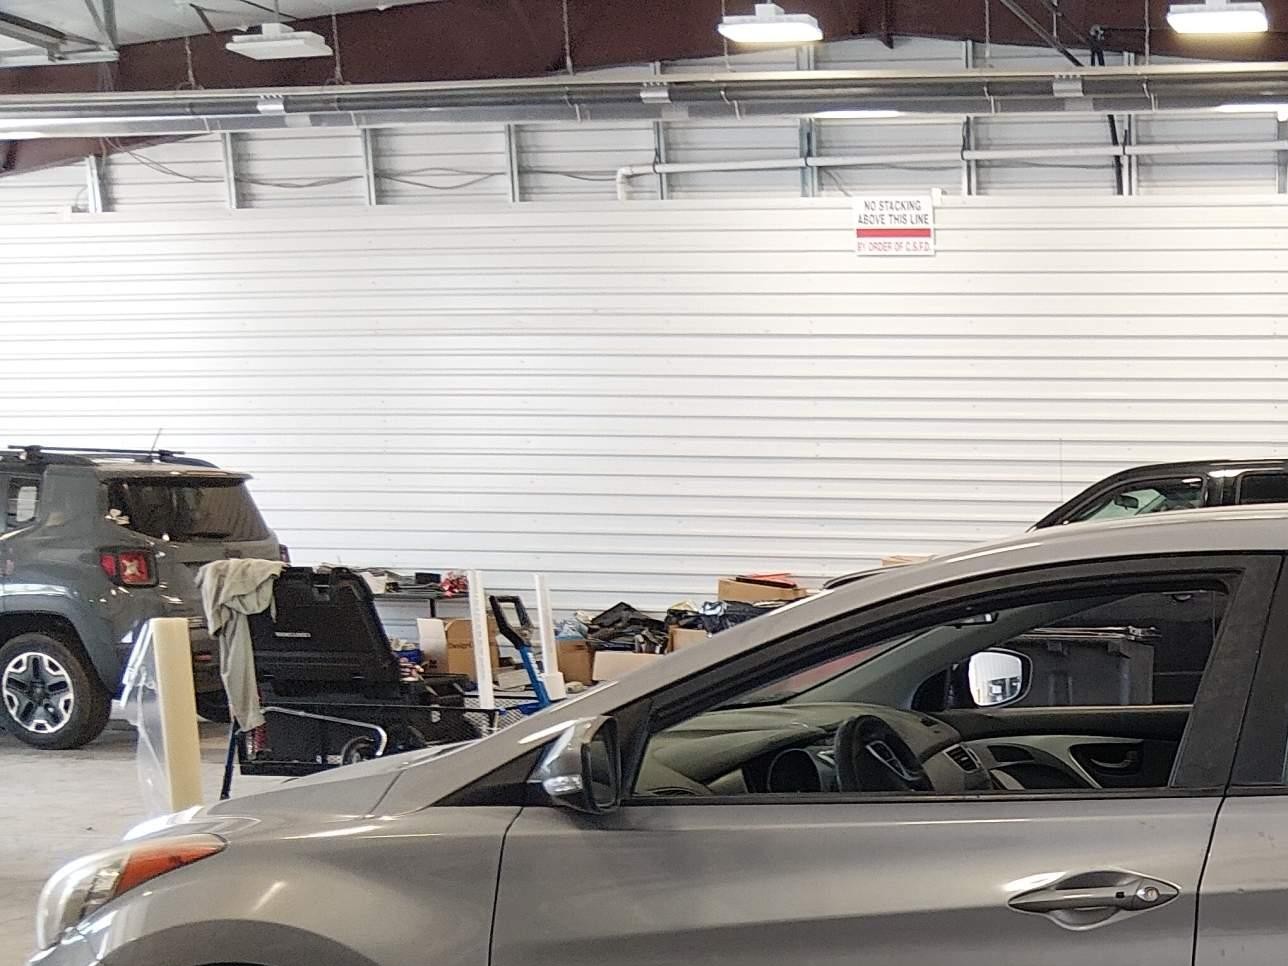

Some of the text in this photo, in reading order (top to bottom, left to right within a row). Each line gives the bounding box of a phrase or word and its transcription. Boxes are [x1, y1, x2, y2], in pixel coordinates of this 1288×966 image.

[864, 200, 921, 211] NO STACKING
[858, 214, 929, 224] ABOVE THIS LINE
